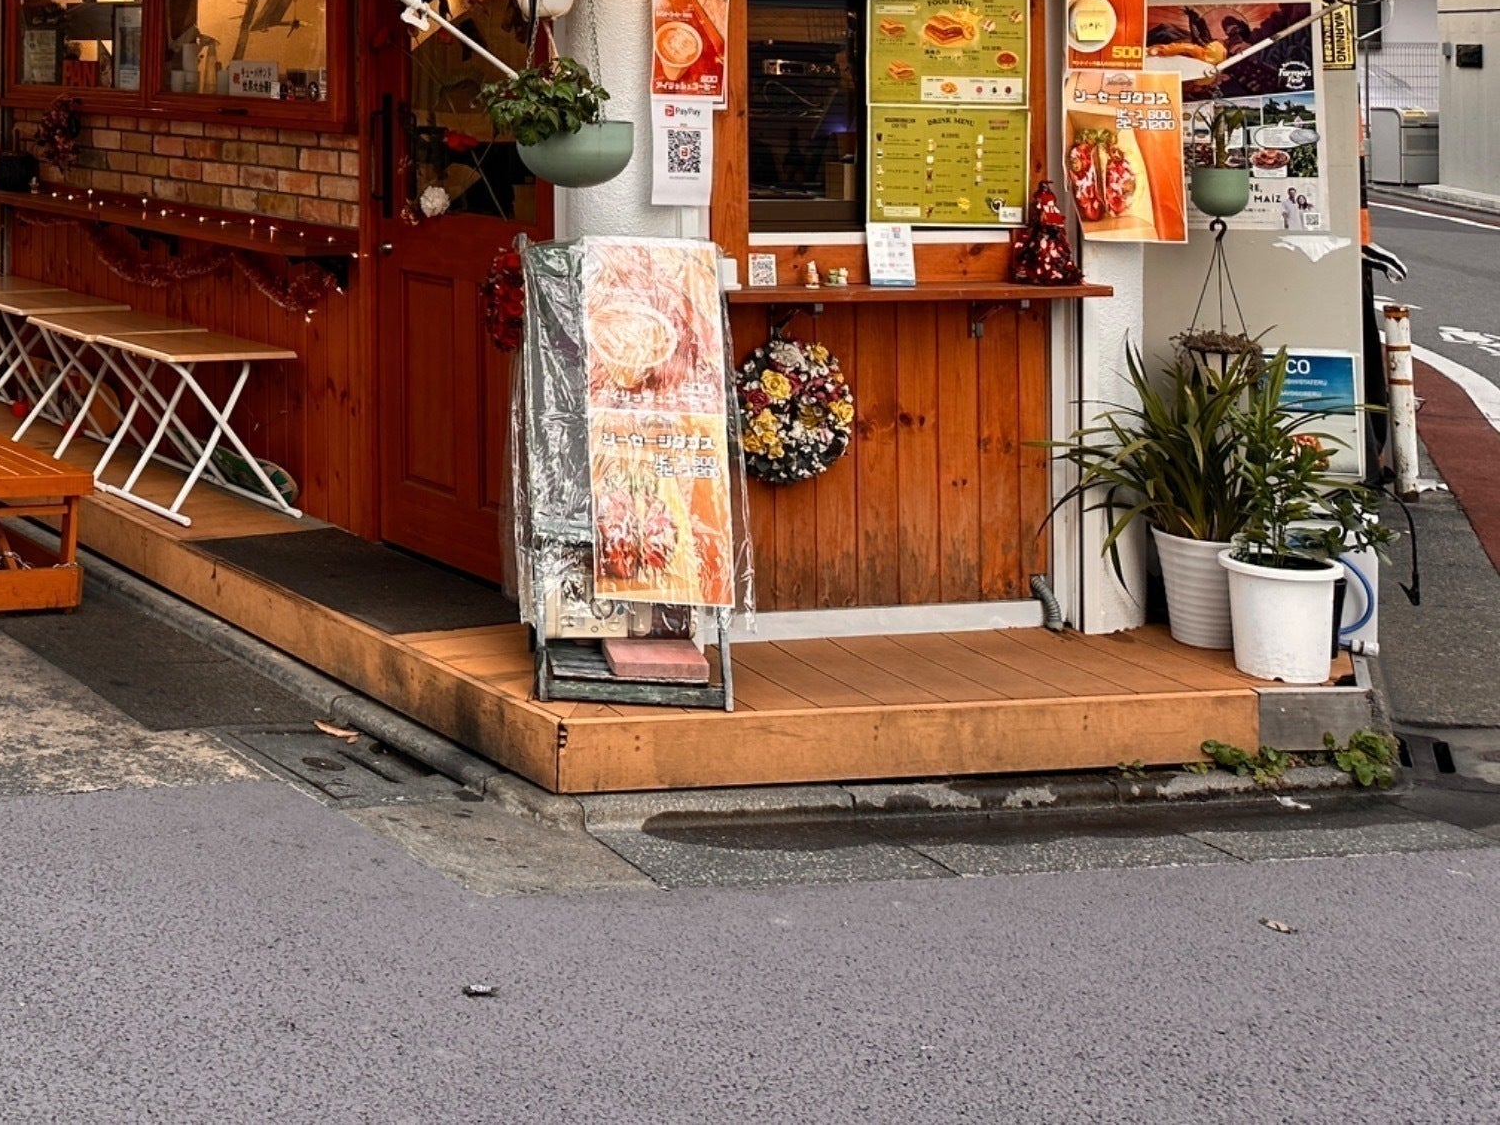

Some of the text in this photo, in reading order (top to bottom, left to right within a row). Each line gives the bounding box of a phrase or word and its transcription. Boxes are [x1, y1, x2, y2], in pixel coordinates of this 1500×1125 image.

[1334, 11, 1347, 63] WARNING
[1111, 46, 1142, 59] 500
[1074, 88, 1171, 105] ソーセージタコス
